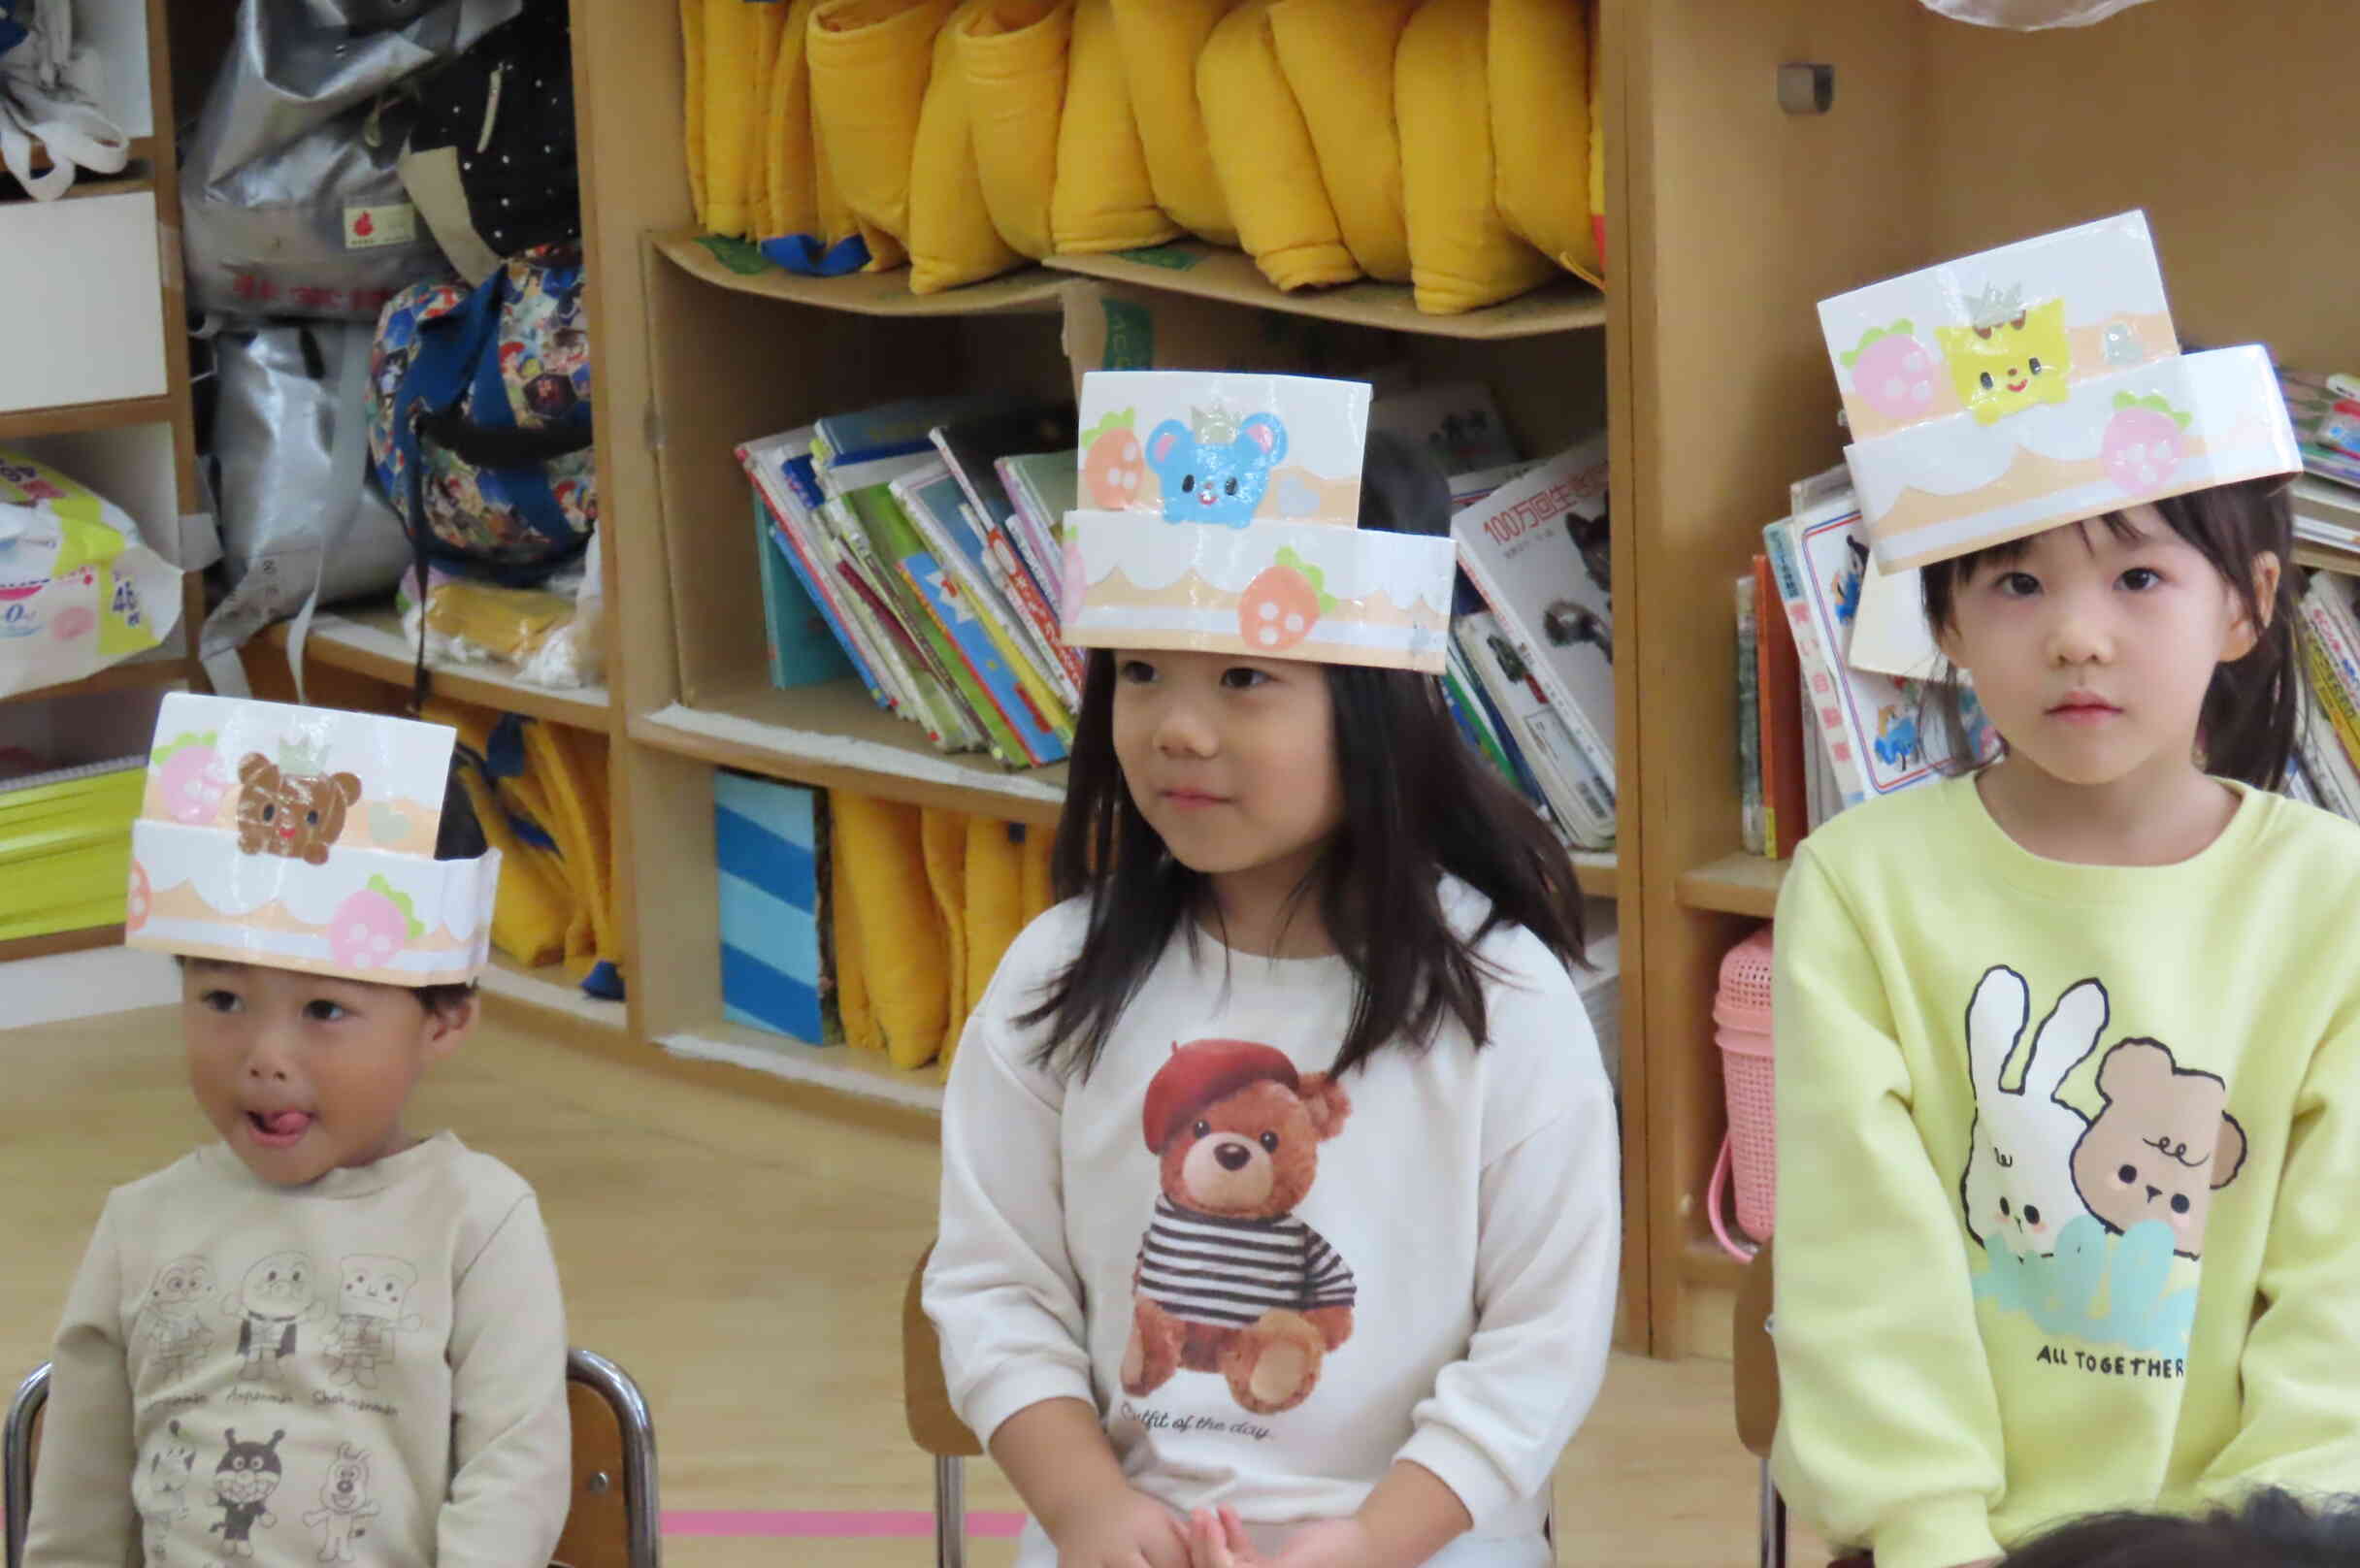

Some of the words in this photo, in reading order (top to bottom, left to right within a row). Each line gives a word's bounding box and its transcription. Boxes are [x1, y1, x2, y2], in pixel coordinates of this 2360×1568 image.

[2036, 1344, 2068, 1365] ALL
[2075, 1351, 2184, 1379] TOGETHER
[1171, 1415, 1194, 1434] of
[1196, 1417, 1226, 1432] the
